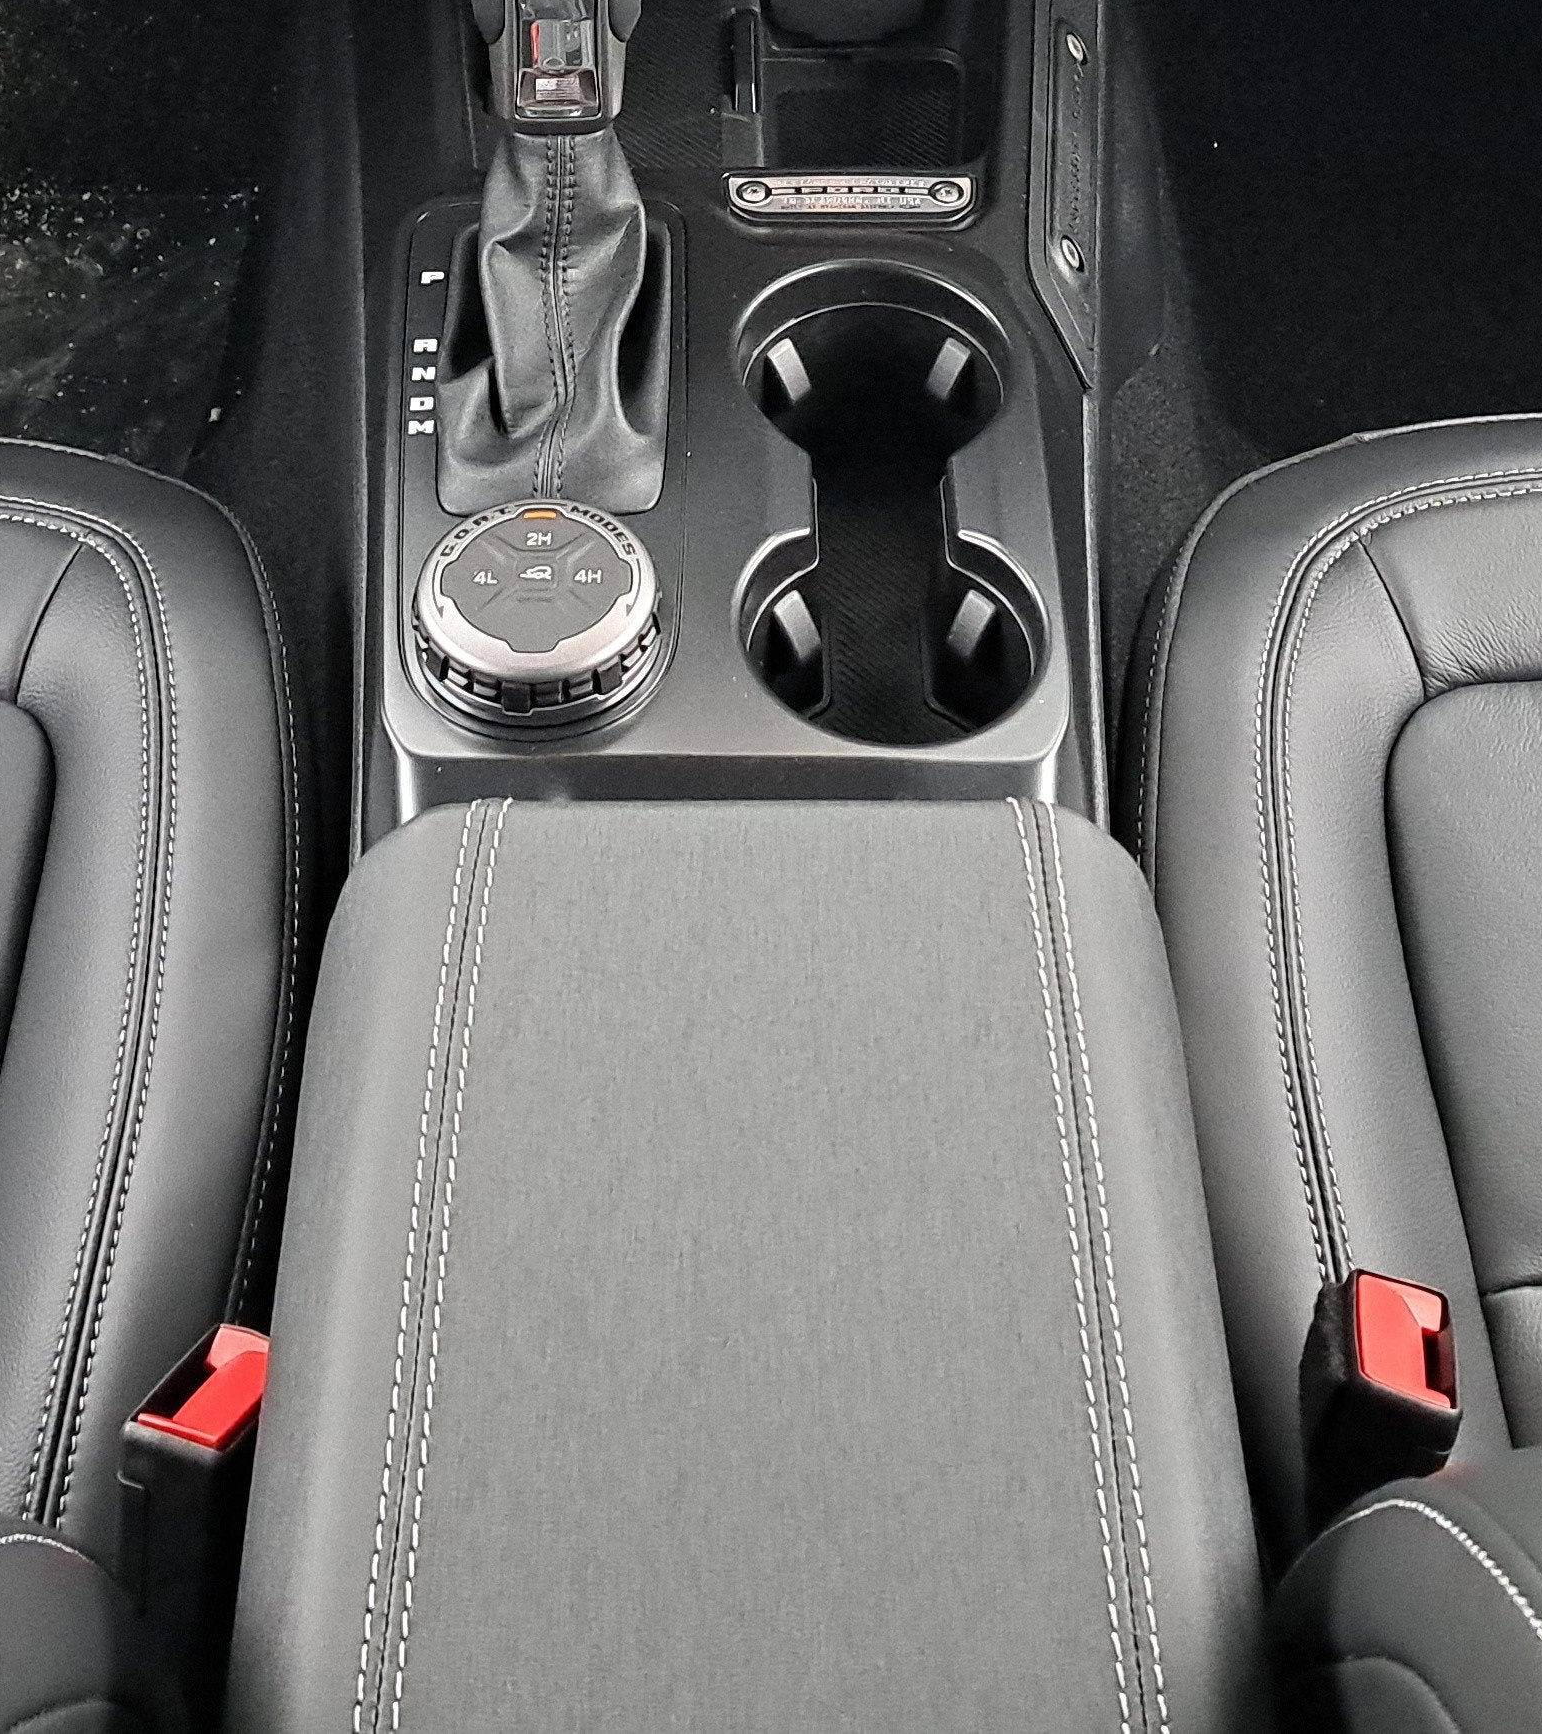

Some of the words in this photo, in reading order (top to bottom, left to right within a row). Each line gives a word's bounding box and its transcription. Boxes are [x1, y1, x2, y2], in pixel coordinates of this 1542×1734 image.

[420, 270, 446, 286] P
[413, 338, 439, 354] R
[411, 366, 437, 381] N
[409, 396, 435, 412] D
[408, 419, 435, 434] M
[570, 505, 637, 556] MODES
[526, 532, 552, 546] 2H
[473, 570, 499, 585] 4L
[574, 569, 603, 584] 4H
